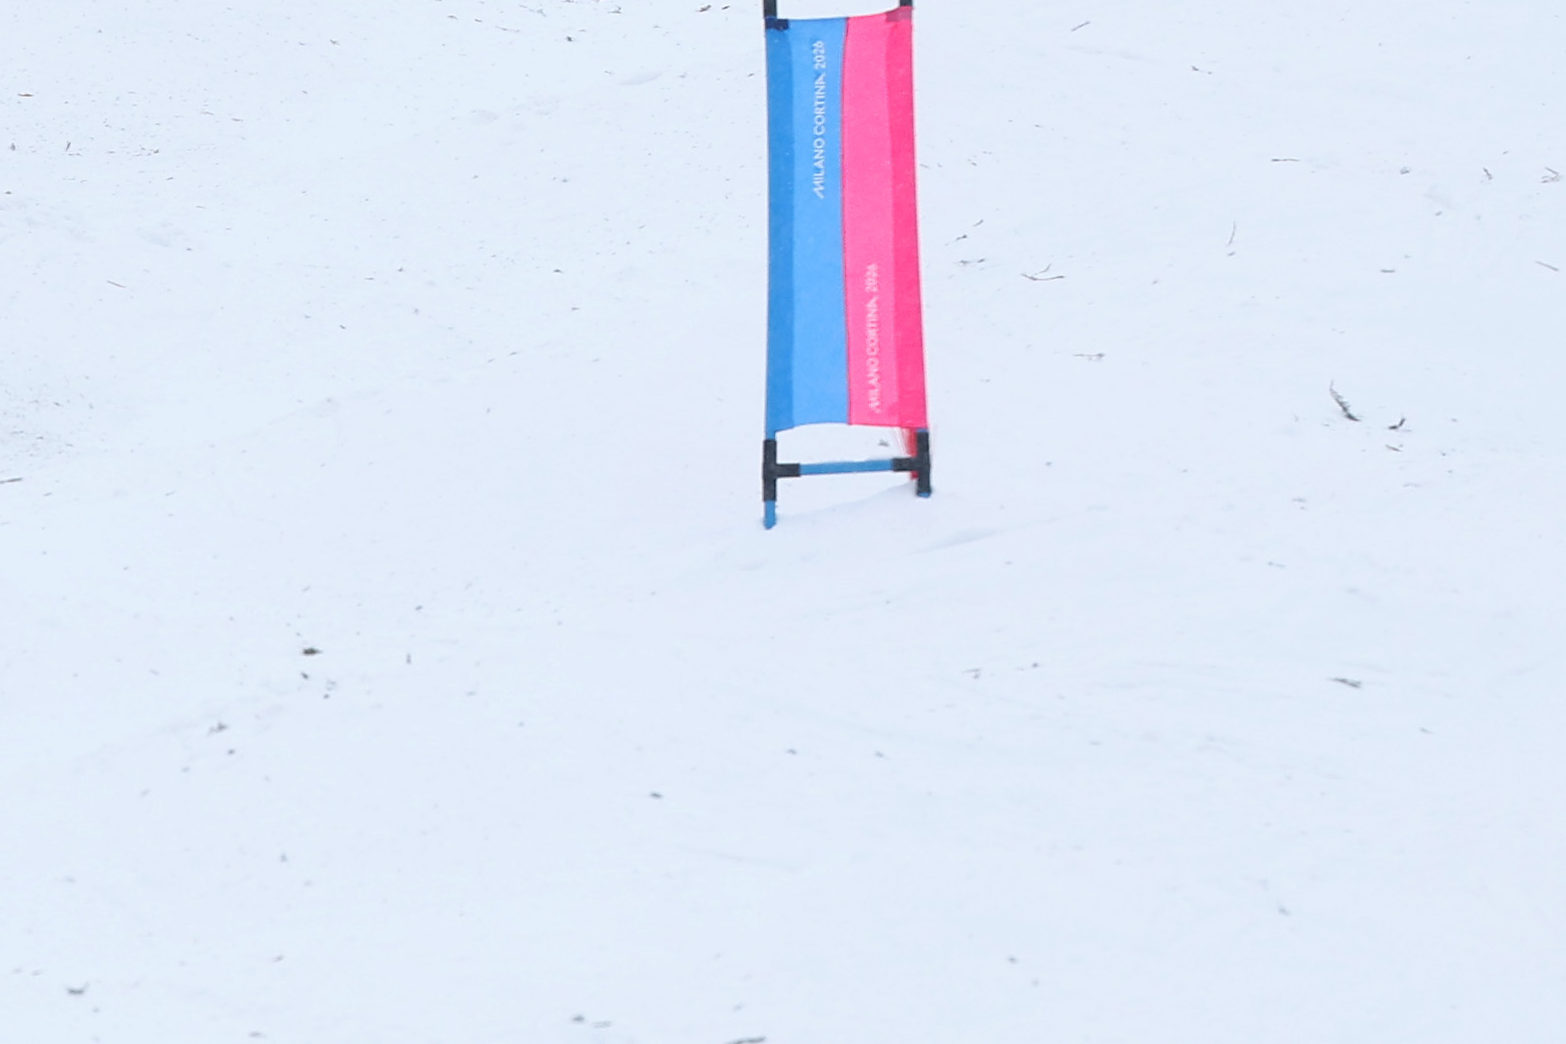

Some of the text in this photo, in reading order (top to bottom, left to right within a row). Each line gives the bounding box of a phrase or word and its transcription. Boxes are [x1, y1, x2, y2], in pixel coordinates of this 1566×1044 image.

[813, 41, 826, 199] MILANO CORTINA 2026
[866, 264, 881, 414] MILANO CORTINA 2026
